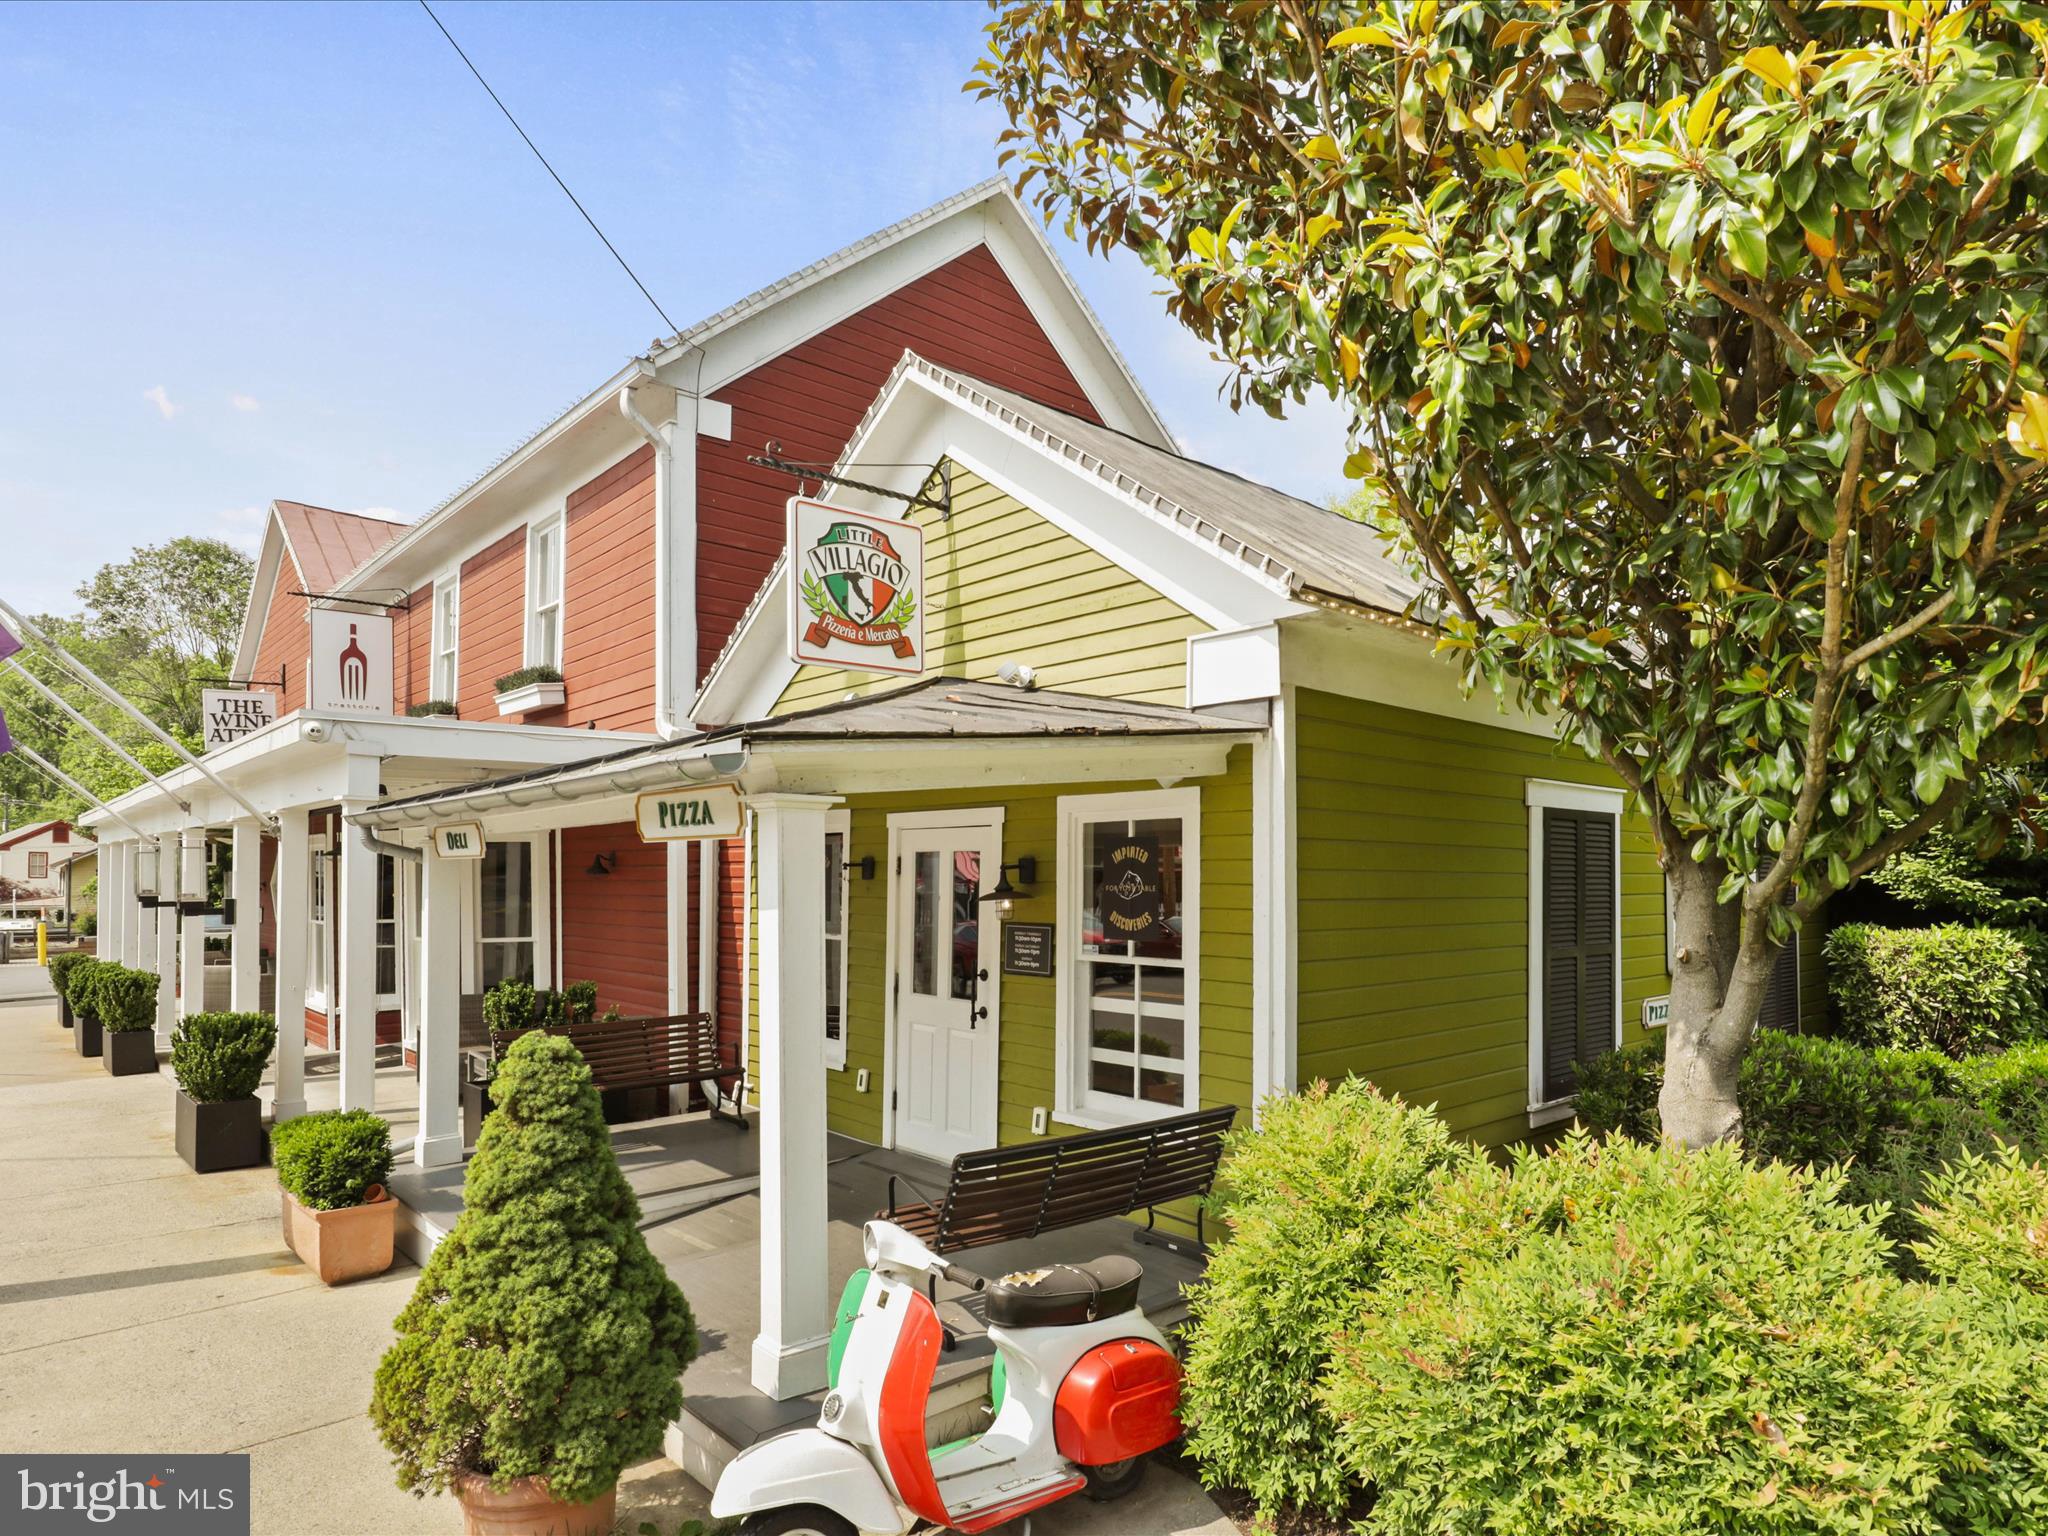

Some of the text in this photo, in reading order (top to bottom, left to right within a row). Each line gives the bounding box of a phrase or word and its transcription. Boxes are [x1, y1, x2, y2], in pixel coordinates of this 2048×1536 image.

[835, 528, 883, 550] LITTLE
[813, 546, 904, 586] VILLAGIO
[822, 616, 899, 642] Pizzeria e Mercato
[217, 698, 264, 714] THE
[209, 728, 256, 742] ATT
[657, 800, 715, 828] PIZZA
[446, 831, 468, 850] DELI
[1111, 846, 1149, 864] IMPORTED
[1109, 910, 1153, 931] DISCOVERIES
[1649, 1004, 1669, 1022] PIZZ
